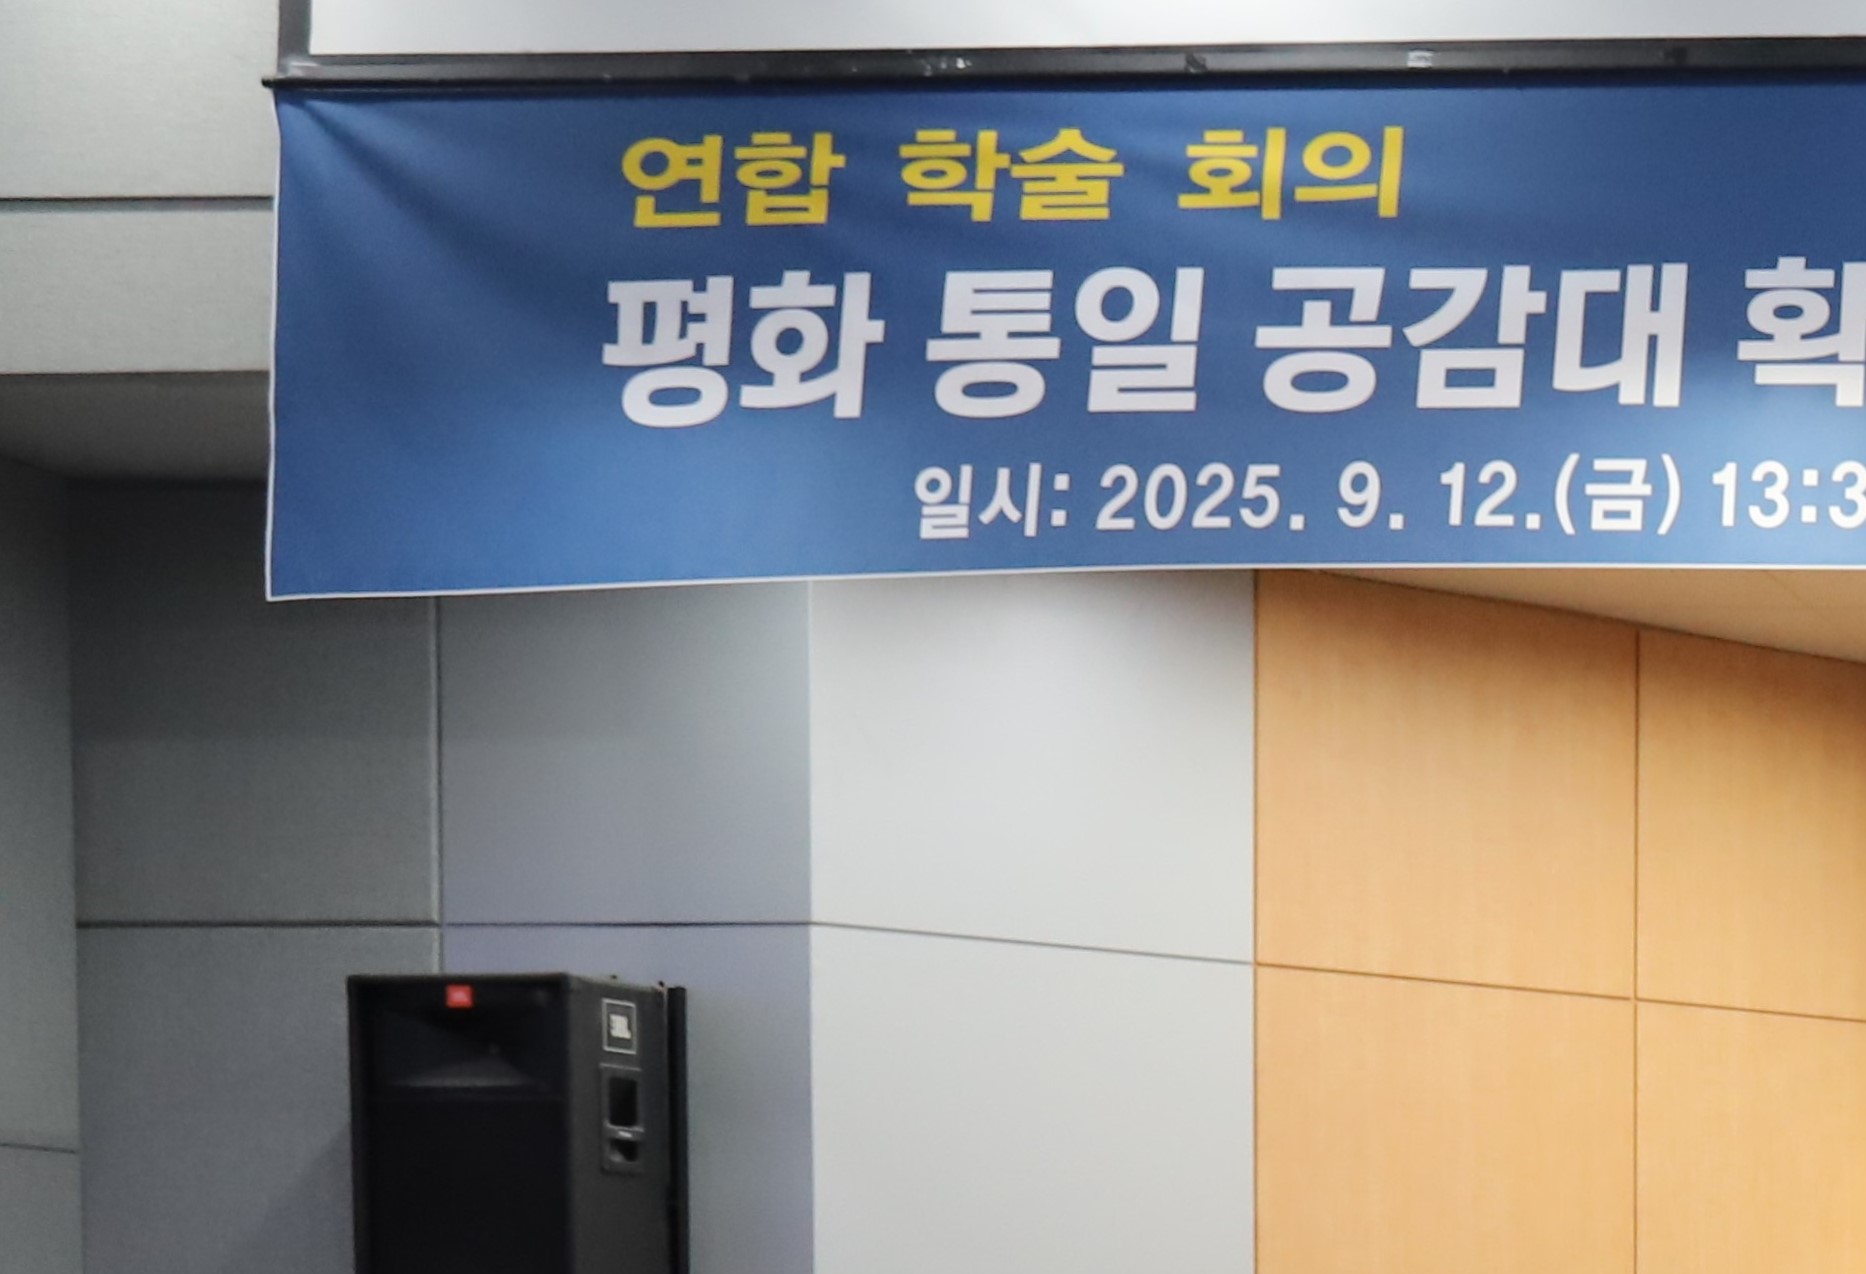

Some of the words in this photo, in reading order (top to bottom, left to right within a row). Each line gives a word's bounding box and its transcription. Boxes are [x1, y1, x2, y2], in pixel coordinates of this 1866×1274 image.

[623, 133, 845, 227] 연합
[900, 128, 1124, 222] 학술
[1178, 126, 1404, 220] 회의
[602, 270, 885, 428] 평화
[926, 266, 1205, 418] 통일
[1254, 263, 1688, 413] 공감대
[914, 462, 1070, 540] 일시:
[1096, 462, 1305, 531] 2025.
[1337, 461, 1404, 530] 9.
